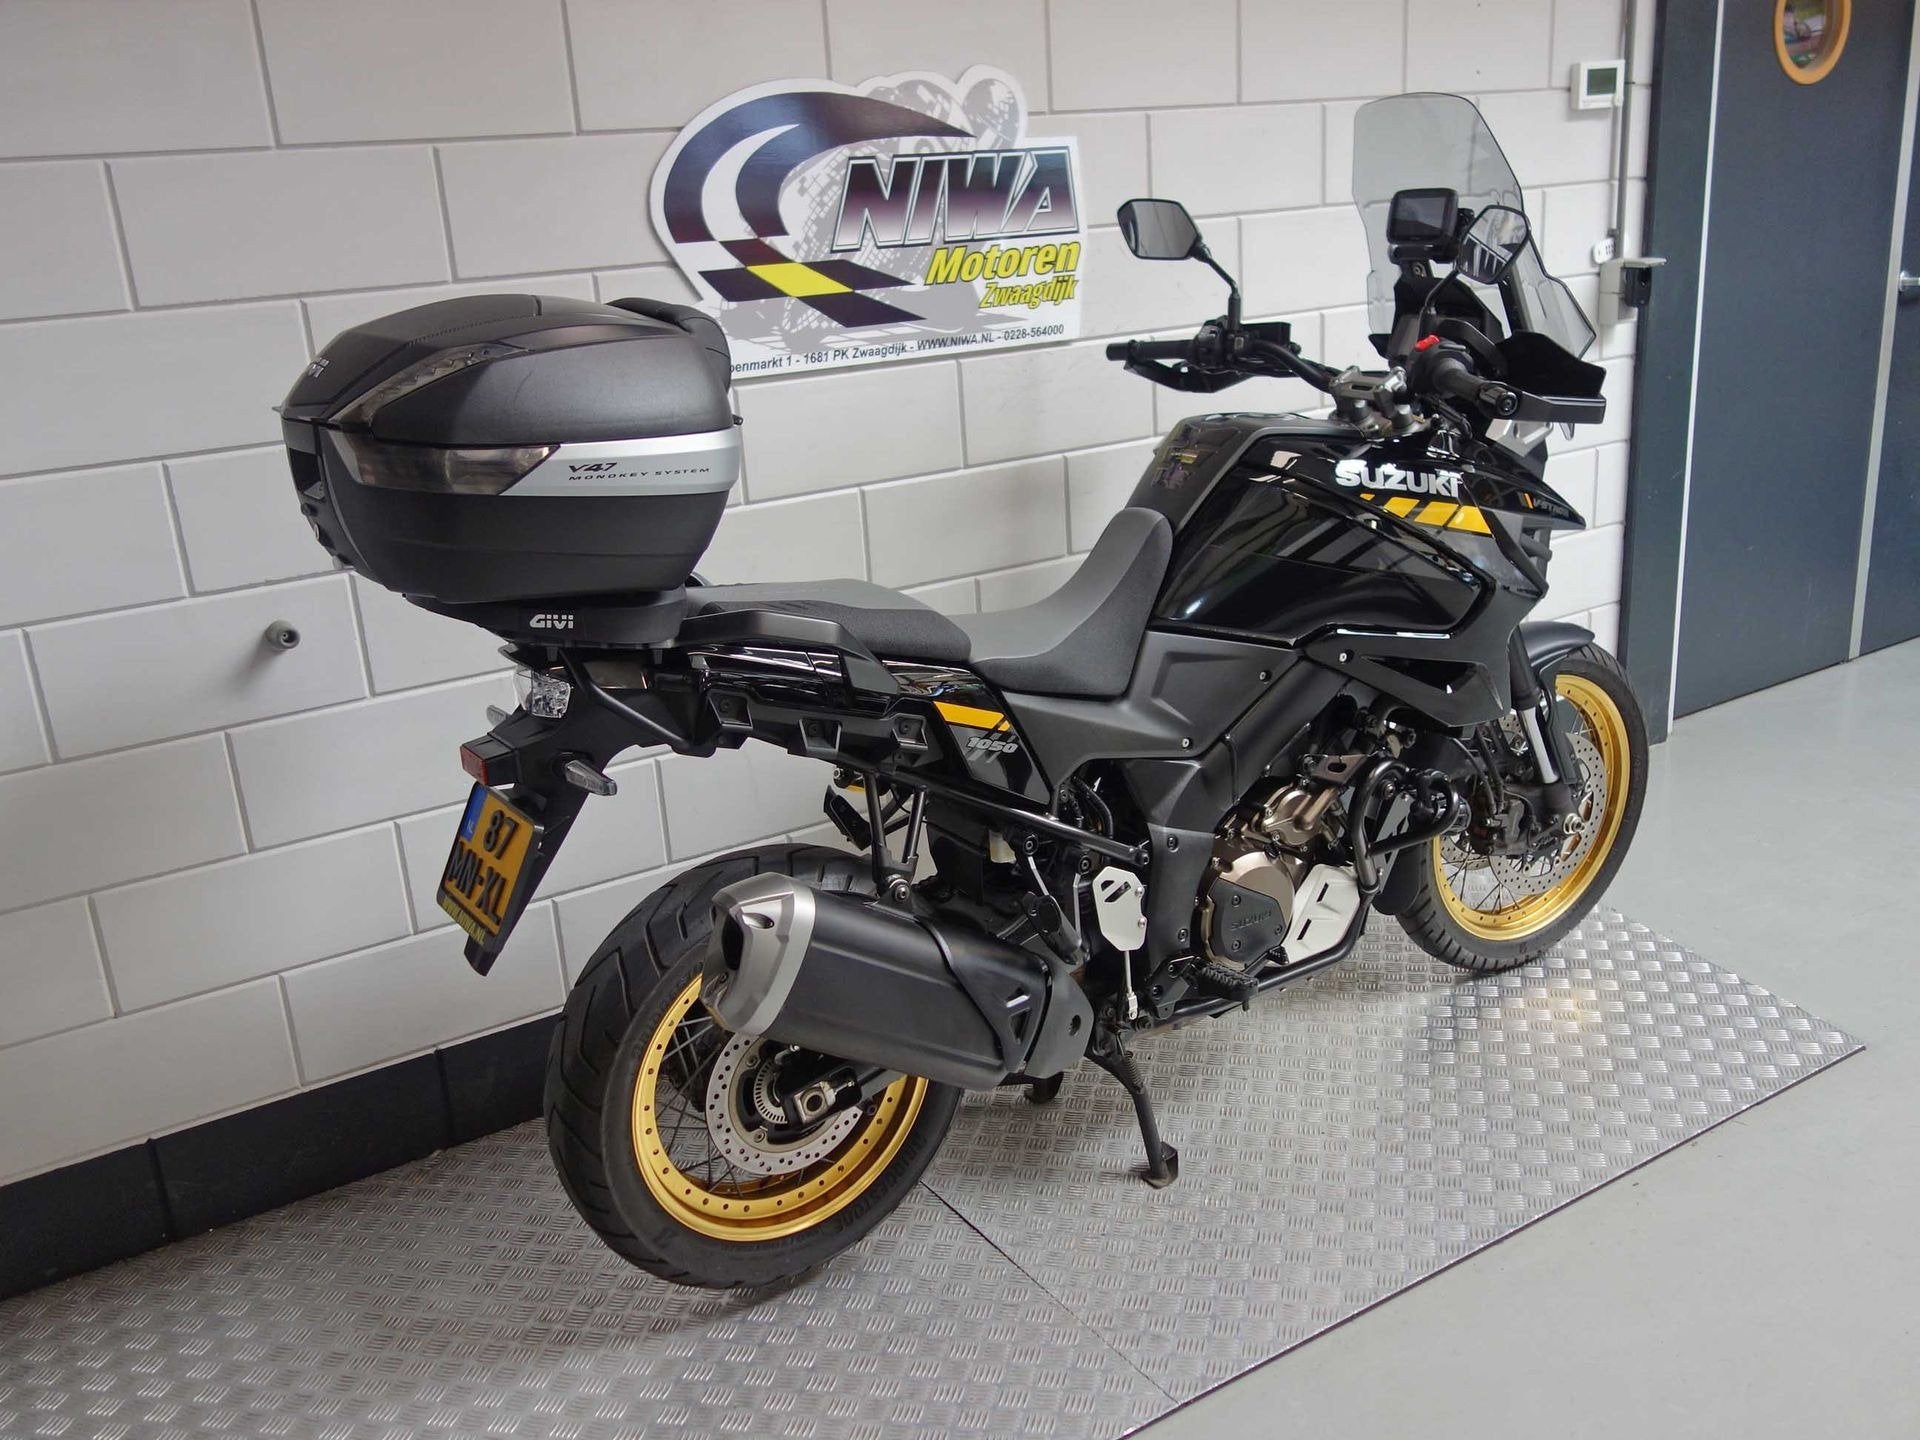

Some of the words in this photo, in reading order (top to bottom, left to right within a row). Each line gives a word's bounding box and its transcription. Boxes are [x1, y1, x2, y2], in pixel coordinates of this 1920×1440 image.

[830, 146, 1080, 253] NIWA
[924, 241, 1082, 285] Motoren
[978, 274, 1079, 309] Zwaagdijk
[786, 355, 792, 366] 1
[803, 350, 829, 365] 1681
[833, 348, 850, 362] PK
[852, 341, 908, 359] Zwaagdijk
[917, 331, 995, 351] WWW.NIWA.NL
[1004, 323, 1065, 341] 0228-564000
[568, 462, 617, 473] V47
[568, 471, 649, 481] MONOKEY
[654, 467, 710, 476] SYSTEM
[1335, 459, 1460, 498] SUZUKI
[529, 613, 574, 630] GIVI
[966, 736, 1019, 754] 1050
[483, 808, 520, 861] 87
